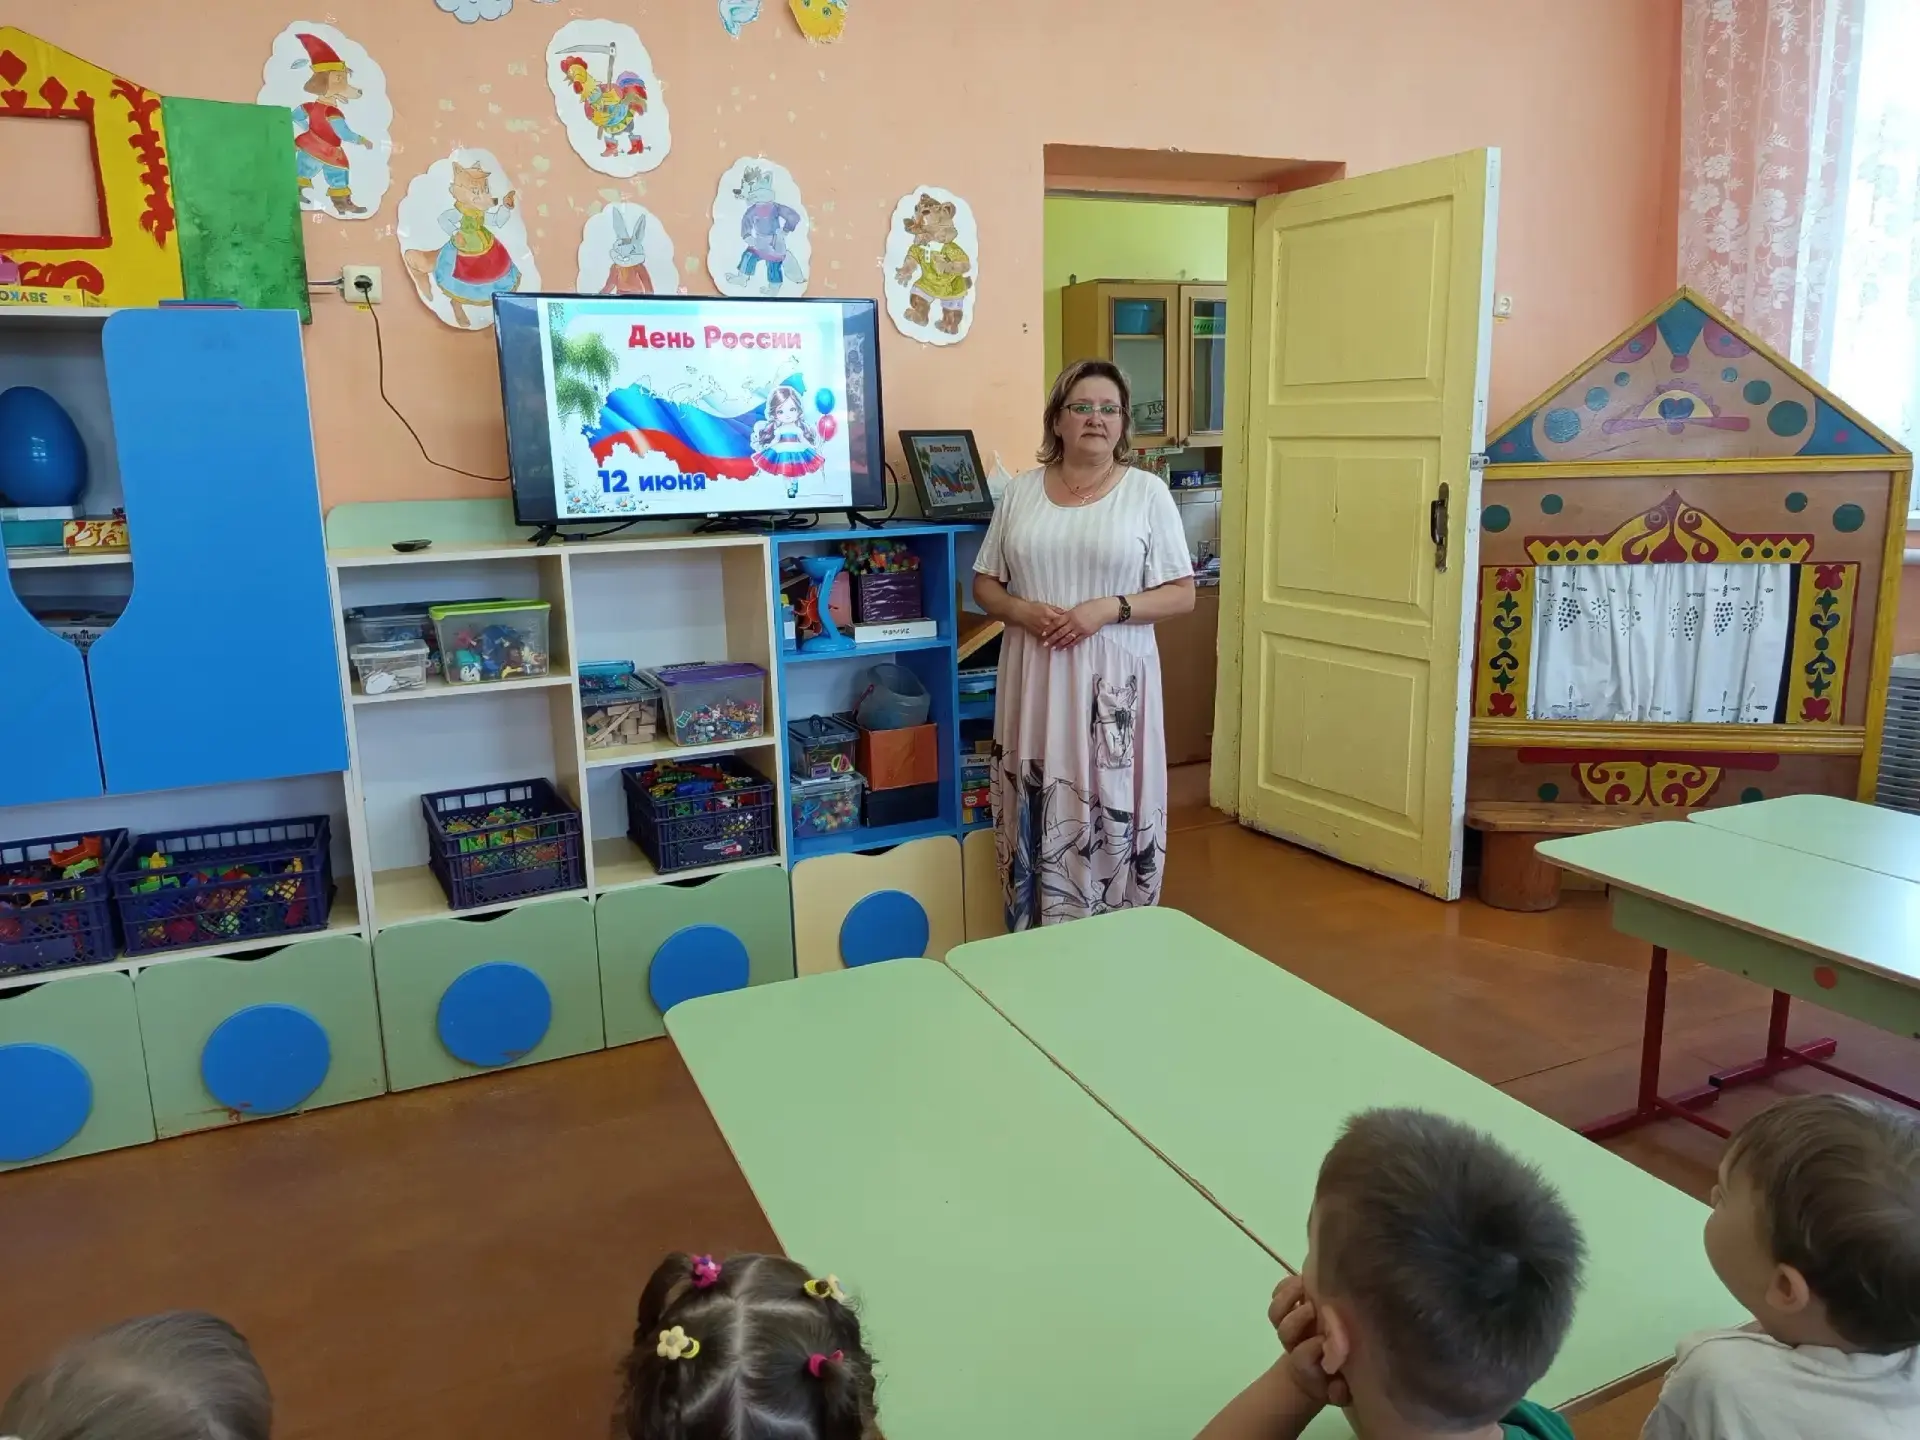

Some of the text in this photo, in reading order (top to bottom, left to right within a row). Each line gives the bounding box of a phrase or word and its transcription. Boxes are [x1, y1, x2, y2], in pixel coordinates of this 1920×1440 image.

[628, 324, 802, 349] День России
[597, 469, 706, 493] 12 июня
